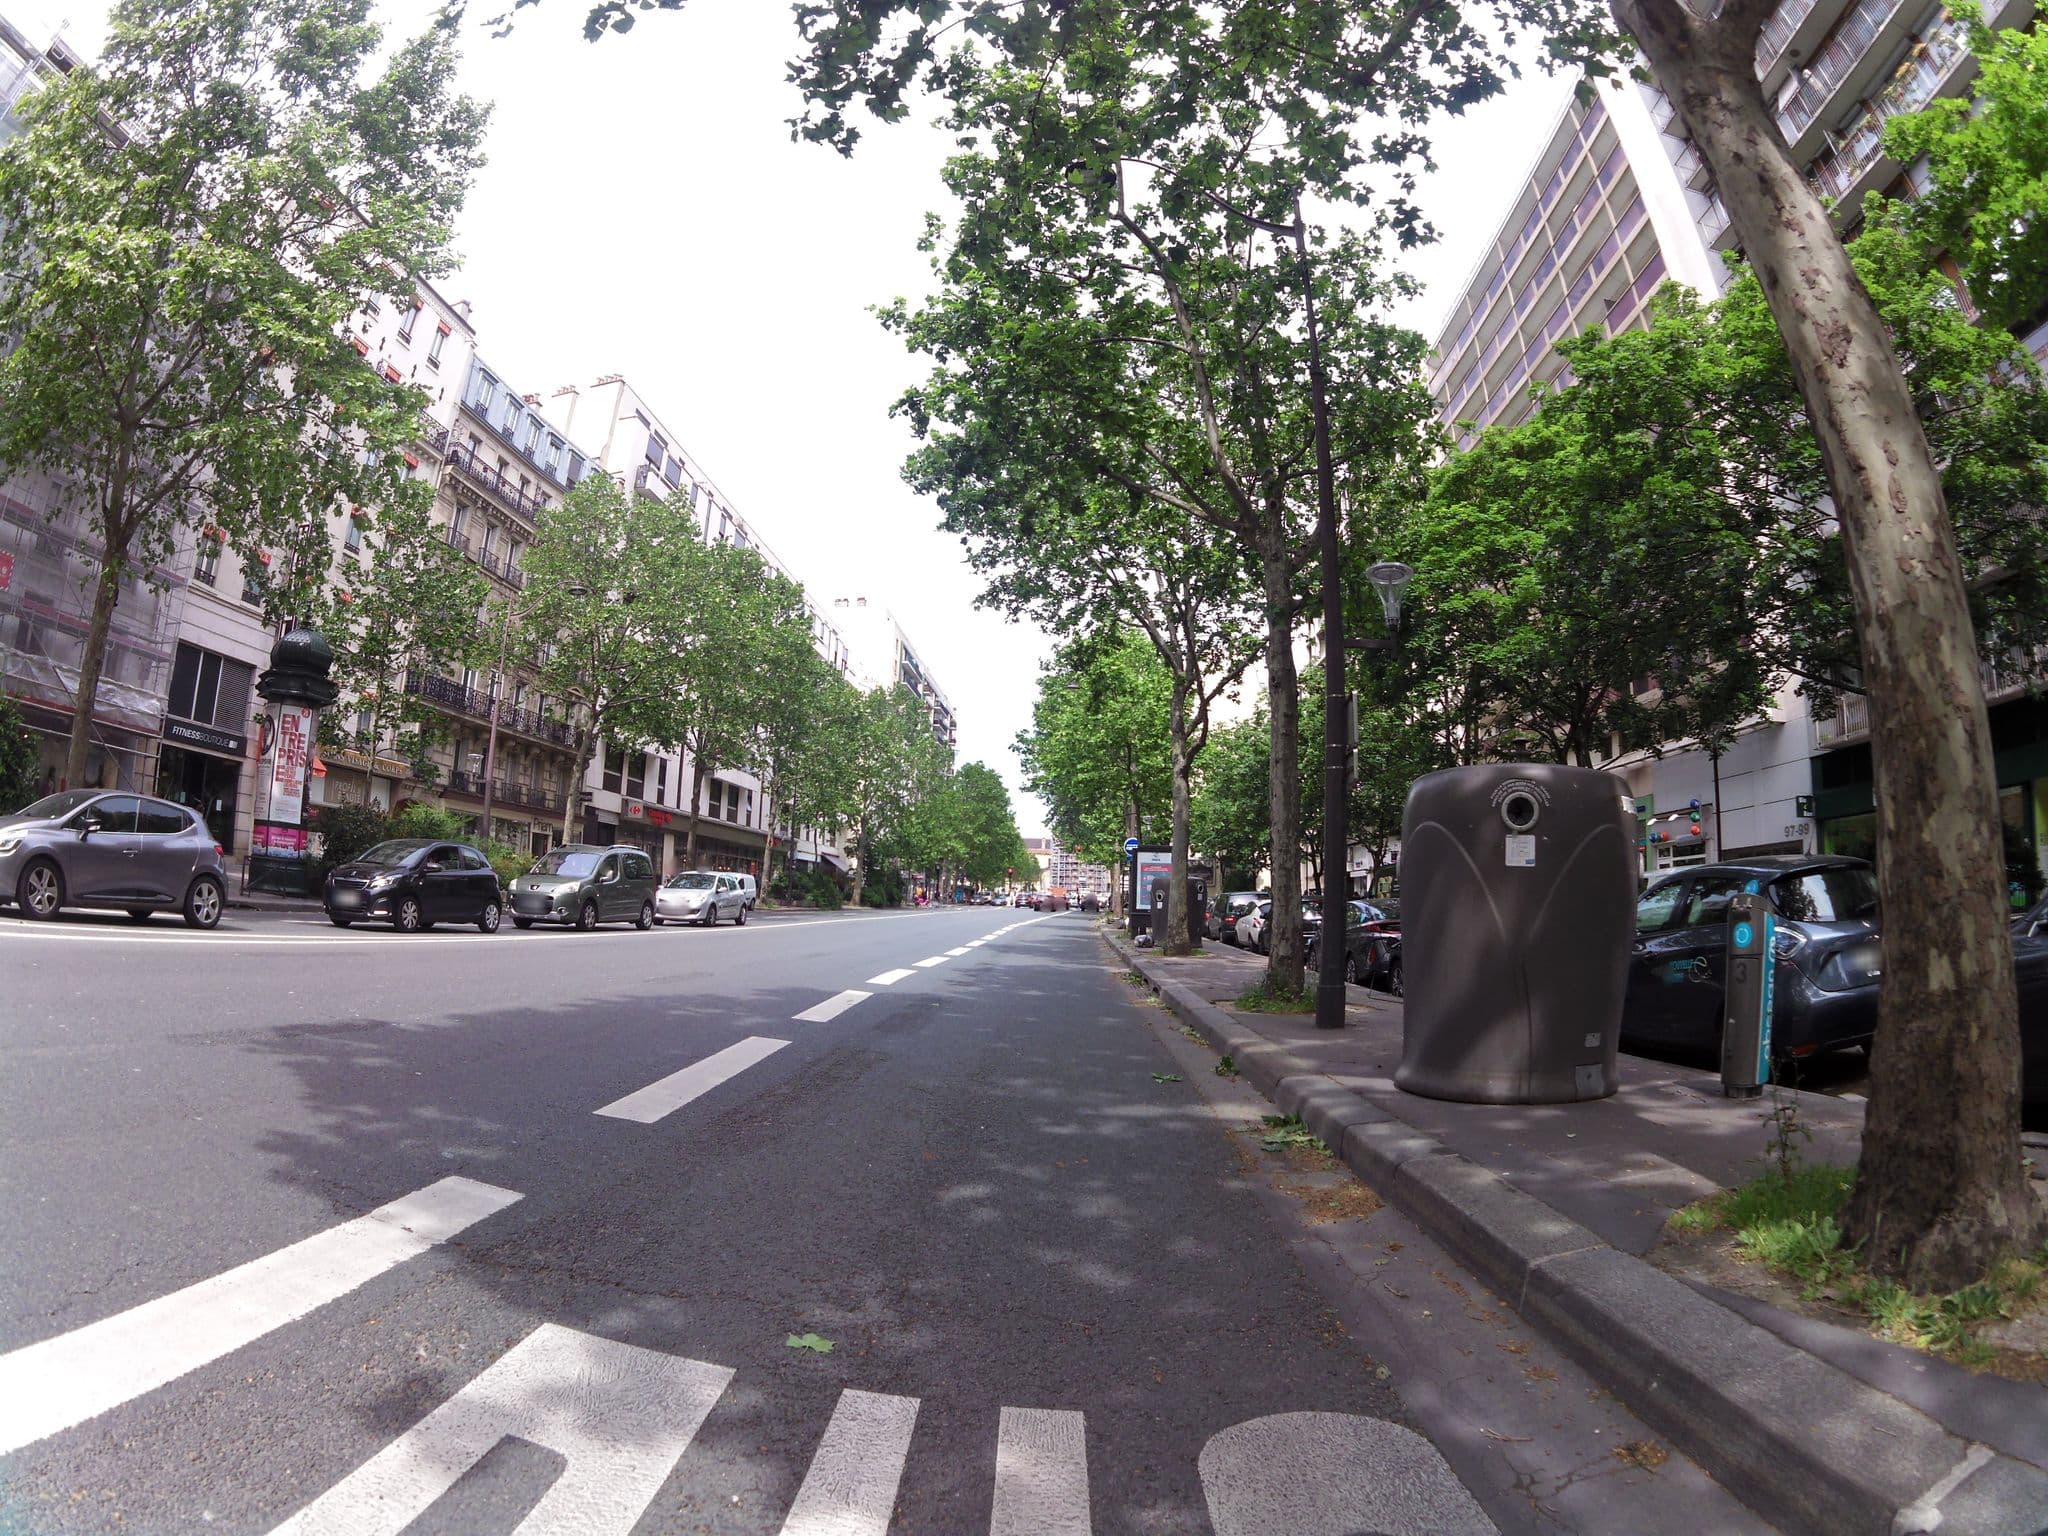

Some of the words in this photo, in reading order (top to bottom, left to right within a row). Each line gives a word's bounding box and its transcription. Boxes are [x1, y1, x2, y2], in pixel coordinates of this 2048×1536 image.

[281, 713, 300, 732] EN
[280, 731, 306, 750] TRE
[278, 748, 306, 767] PRIS
[1784, 823, 1809, 837] 97-99
